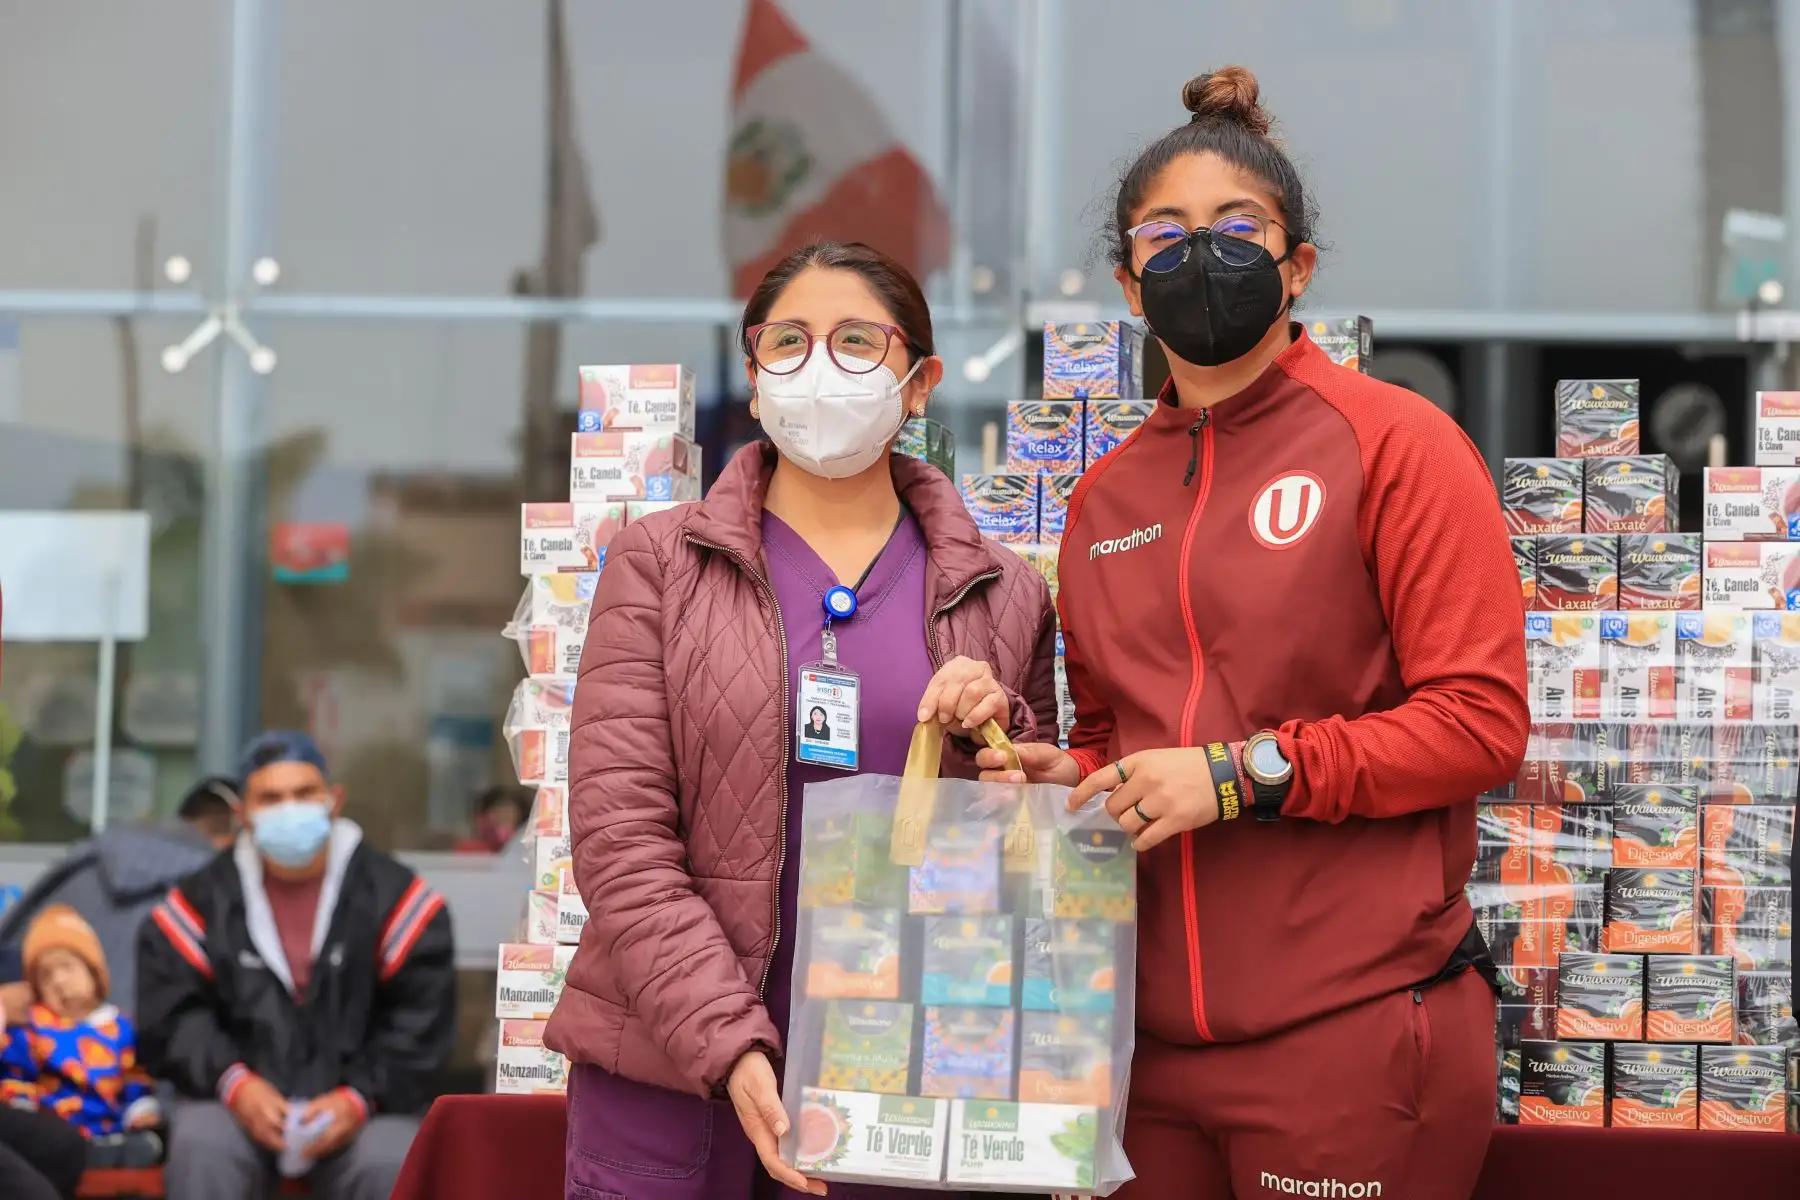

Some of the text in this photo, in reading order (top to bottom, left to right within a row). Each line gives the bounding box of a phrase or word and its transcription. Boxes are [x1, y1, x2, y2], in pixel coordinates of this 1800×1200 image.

[1065, 362, 1099, 374] Relax
[1028, 442, 1063, 454] Relax
[1269, 484, 1310, 540] U
[1725, 503, 1760, 517] Canela
[983, 516, 1017, 527] Relax
[541, 538, 573, 551] Canela
[1089, 523, 1162, 561] marathon
[1547, 554, 1608, 566] Wawasana
[1628, 553, 1689, 564] Wawasana
[1724, 578, 1759, 592] Canela
[1558, 597, 1598, 610] Laxaté
[1640, 596, 1681, 610] Laxaté
[1620, 803, 1686, 815] Wawasana
[1628, 847, 1684, 865] Digestivo
[1617, 886, 1682, 898] Wawasana
[1624, 931, 1680, 947] Digestivo
[1566, 973, 1632, 986] Wawasana
[1655, 974, 1721, 987] Wawasana
[500, 987, 555, 1003] Manzanilla
[1573, 1018, 1629, 1035] Digestivo
[1663, 1020, 1720, 1036] Digestivo
[500, 1063, 552, 1079] Manzanilla
[1529, 1060, 1594, 1073] Wawasana
[1621, 1063, 1686, 1075] Wawasana
[1709, 1065, 1775, 1078] Wawasana
[1535, 1105, 1590, 1123] Digestivo
[1628, 1108, 1684, 1125] Digestivo
[1715, 1110, 1771, 1128] Digestivo
[866, 1125, 933, 1157] Té Verde
[962, 1134, 1024, 1161] Té Verde
[1261, 1169, 1382, 1199] marathon
